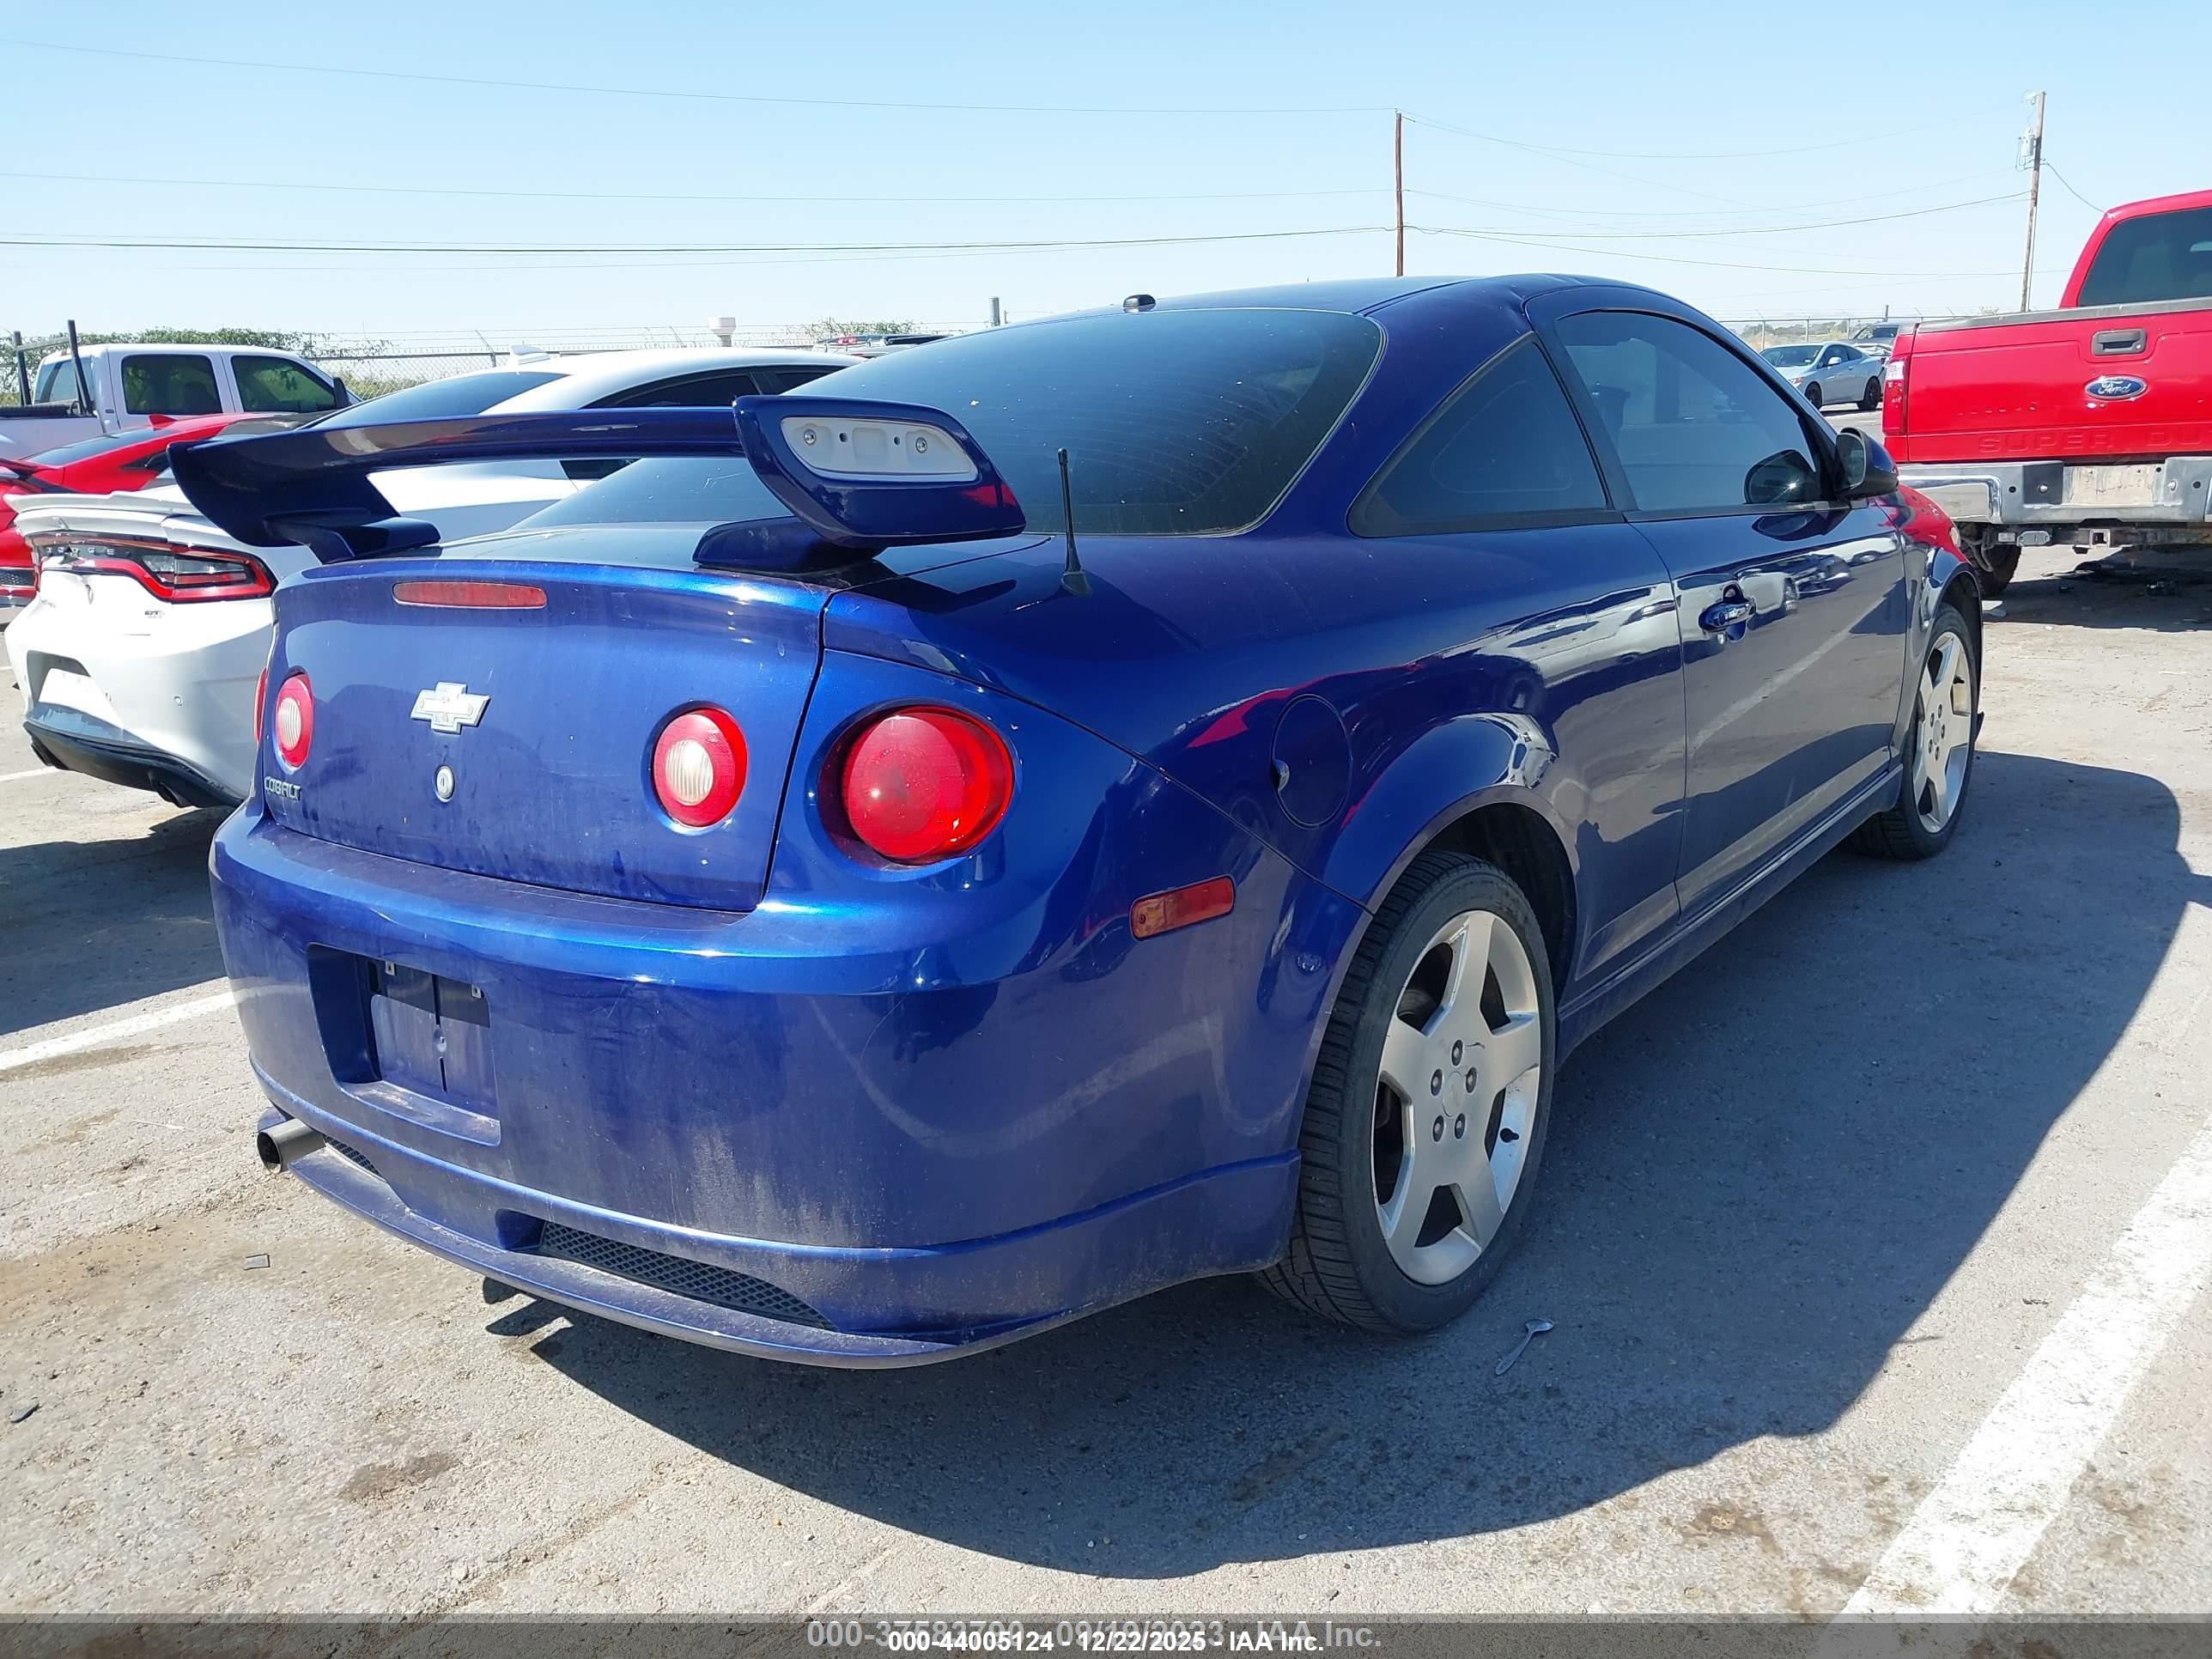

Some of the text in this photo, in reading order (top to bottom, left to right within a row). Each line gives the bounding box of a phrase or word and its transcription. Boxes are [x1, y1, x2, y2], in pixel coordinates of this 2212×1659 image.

[2098, 380, 2131, 394] Ford
[1978, 433, 2113, 453] SUPER
[264, 776, 301, 800] COBALT
